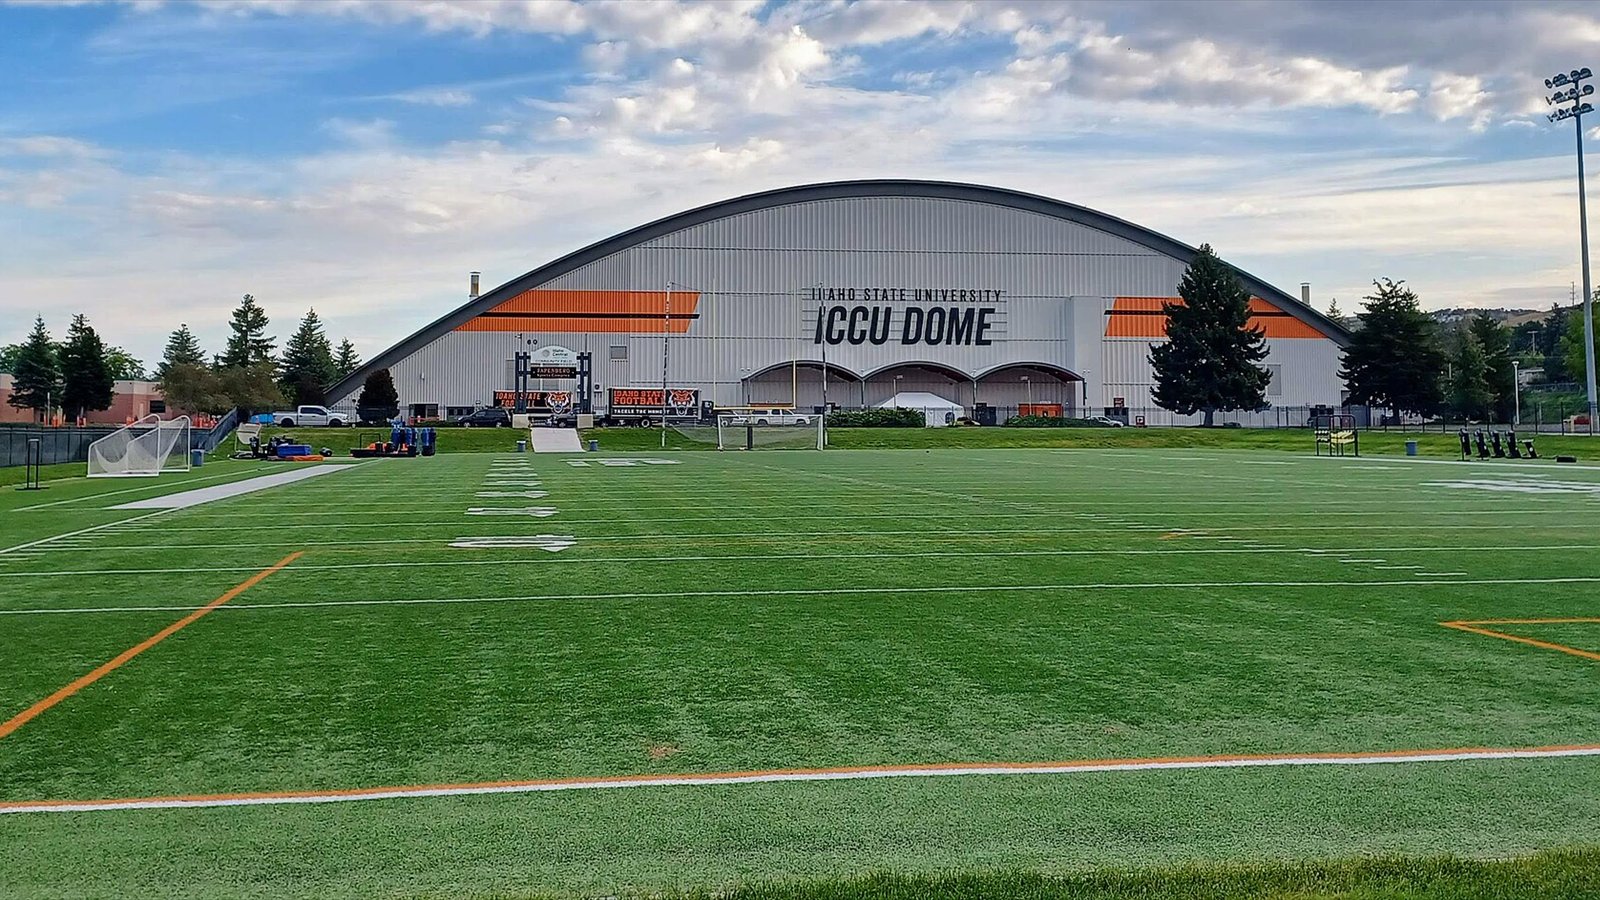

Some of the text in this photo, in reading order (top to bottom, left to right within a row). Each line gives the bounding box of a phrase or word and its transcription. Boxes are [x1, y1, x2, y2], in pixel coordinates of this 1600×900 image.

[864, 288, 906, 301] STATE
[915, 288, 1001, 302] UNIVERSITY
[814, 305, 996, 346] ICCU DOME
[501, 400, 535, 408] FOOLL
